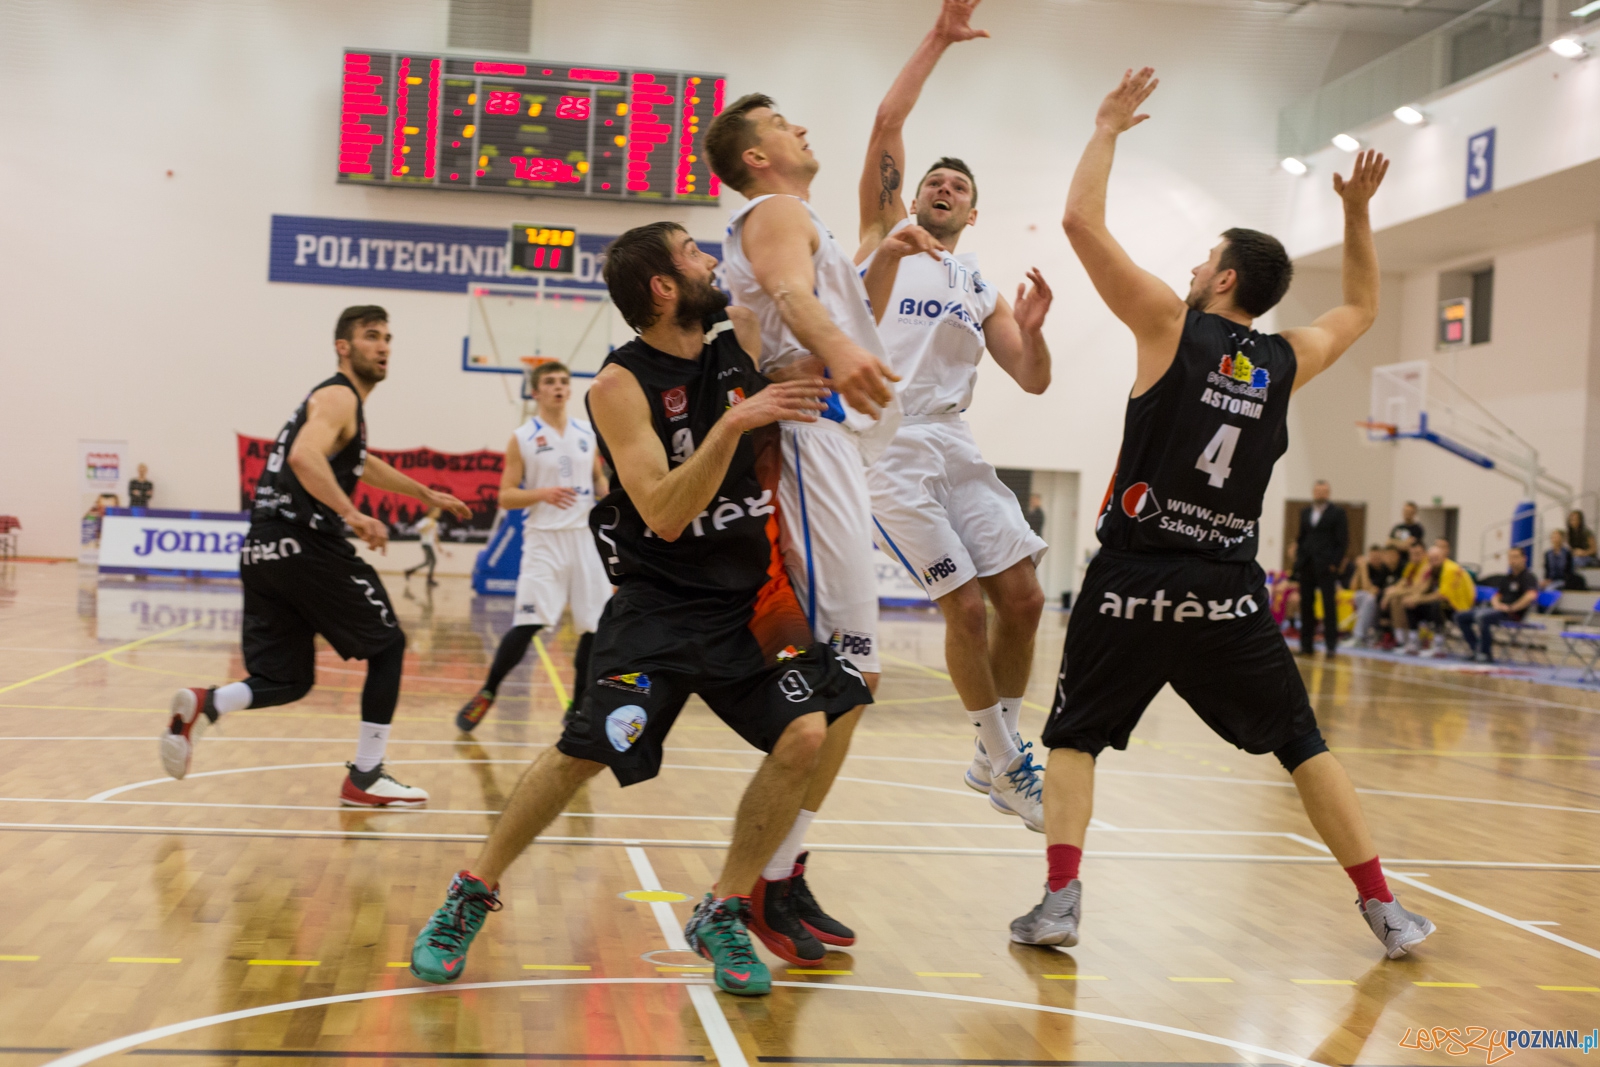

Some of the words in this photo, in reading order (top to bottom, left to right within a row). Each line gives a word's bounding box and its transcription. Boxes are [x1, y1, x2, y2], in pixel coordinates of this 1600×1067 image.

[1469, 135, 1489, 190] 3
[1200, 387, 1264, 420] ASTORIA
[670, 427, 695, 463] 9
[1195, 423, 1242, 489] 4
[133, 528, 245, 556] Joma
[1159, 515, 1208, 542] Szkoły
[928, 557, 957, 582] PBG
[841, 633, 871, 656] PBG
[778, 669, 814, 703] 9
